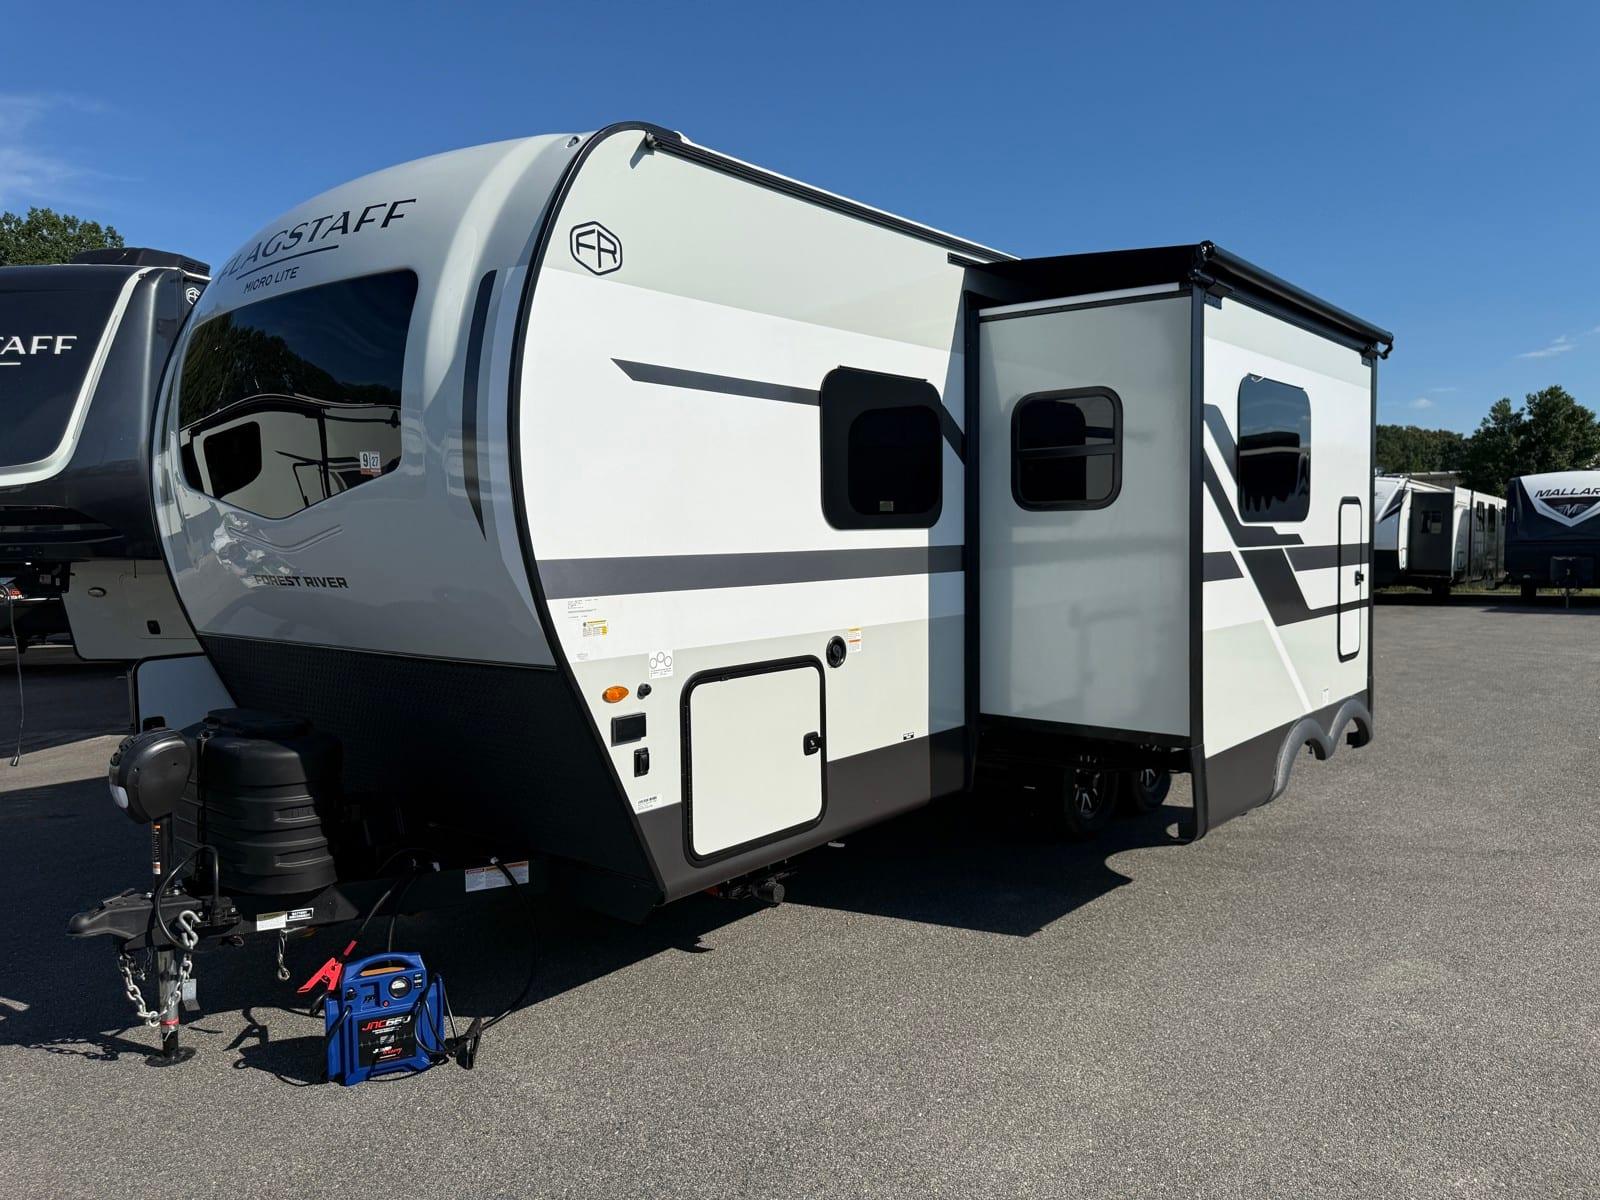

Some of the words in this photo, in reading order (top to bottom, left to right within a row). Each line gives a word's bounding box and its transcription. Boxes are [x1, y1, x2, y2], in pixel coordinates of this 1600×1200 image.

[216, 199, 416, 284] FLAGSTAFF
[243, 273, 272, 294] MICRO
[274, 267, 299, 284] LITE
[0, 335, 77, 355] AFF
[362, 453, 369, 467] 9
[254, 574, 301, 587] FOREST
[303, 576, 349, 588] RIVER
